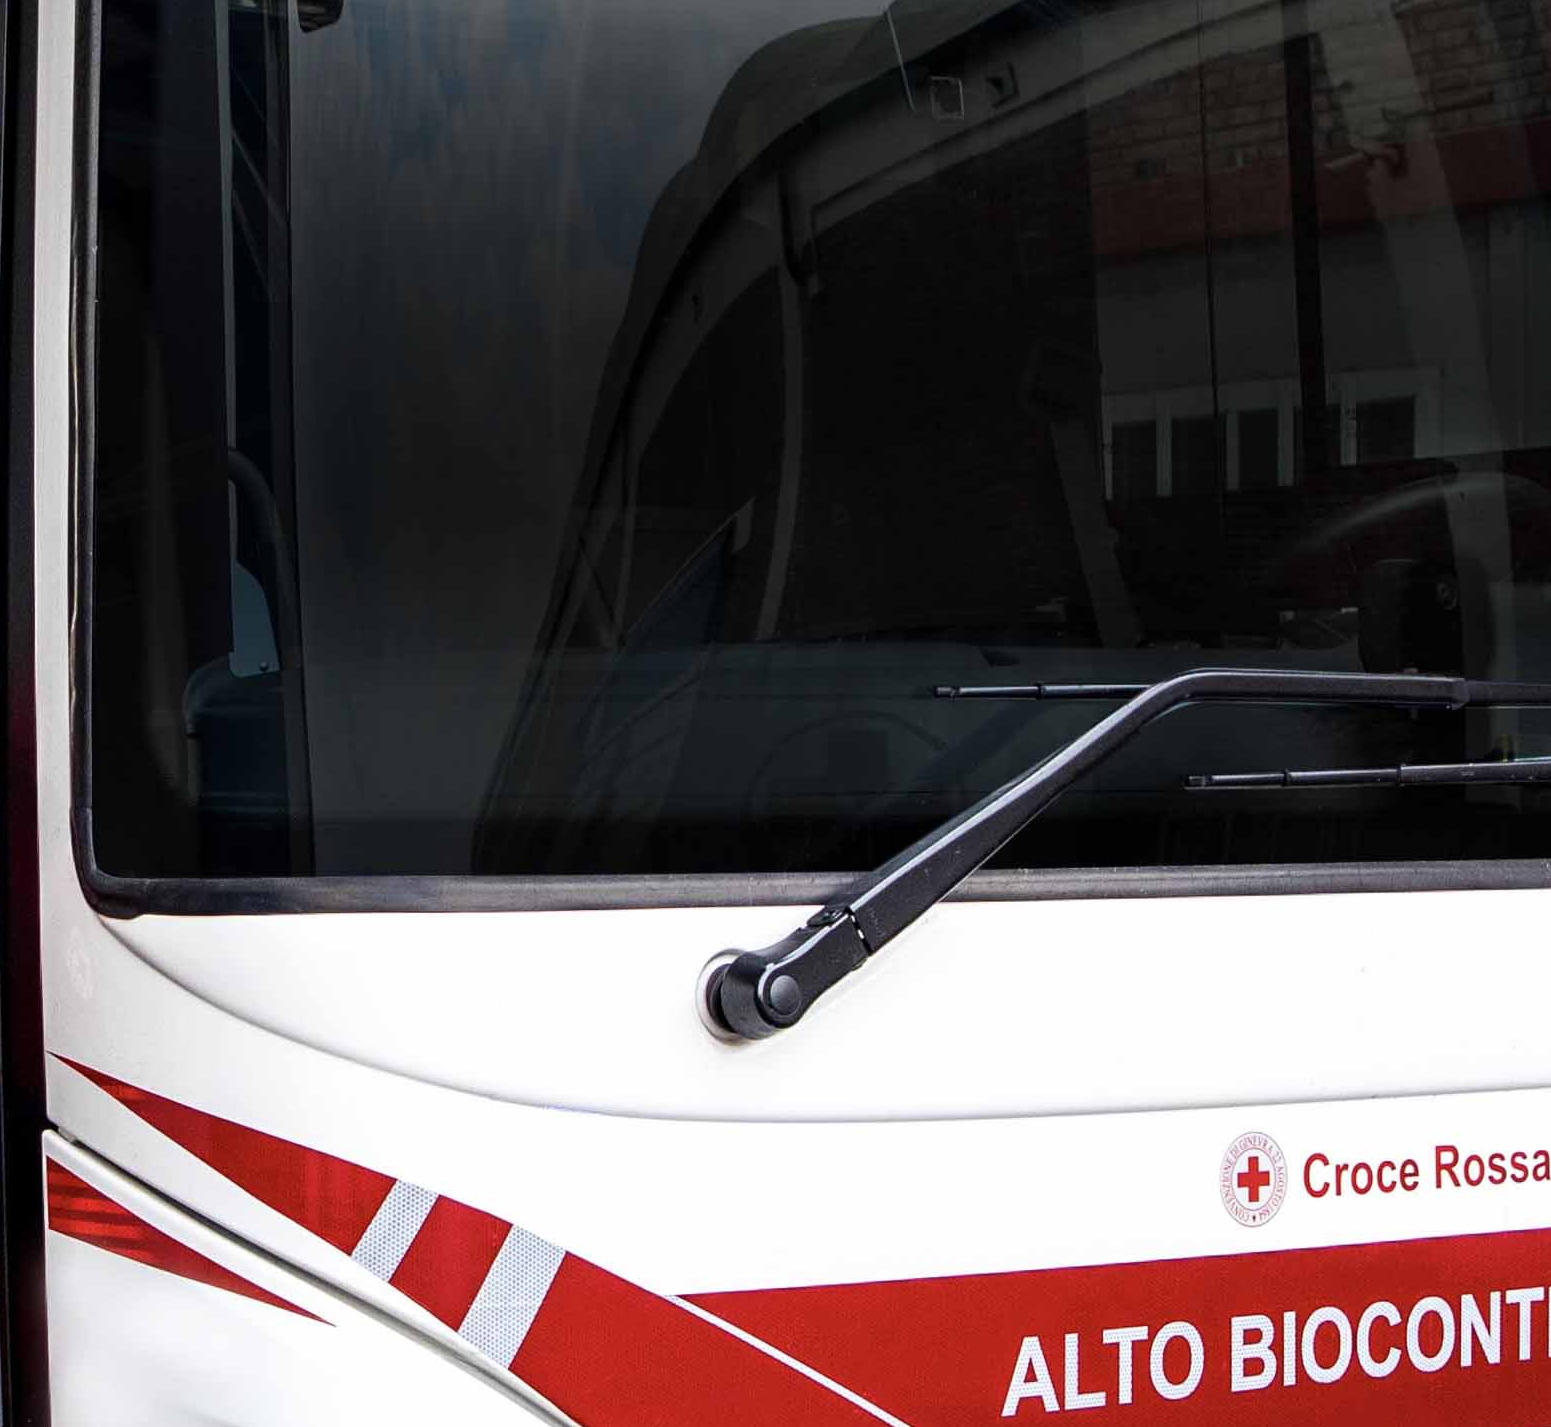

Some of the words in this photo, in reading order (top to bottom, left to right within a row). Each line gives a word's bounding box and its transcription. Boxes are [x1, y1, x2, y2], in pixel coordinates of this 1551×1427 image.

[1303, 1152, 1419, 1199] Croce
[1433, 1144, 1551, 1190] Rossa
[1001, 1321, 1205, 1417] ALTO
